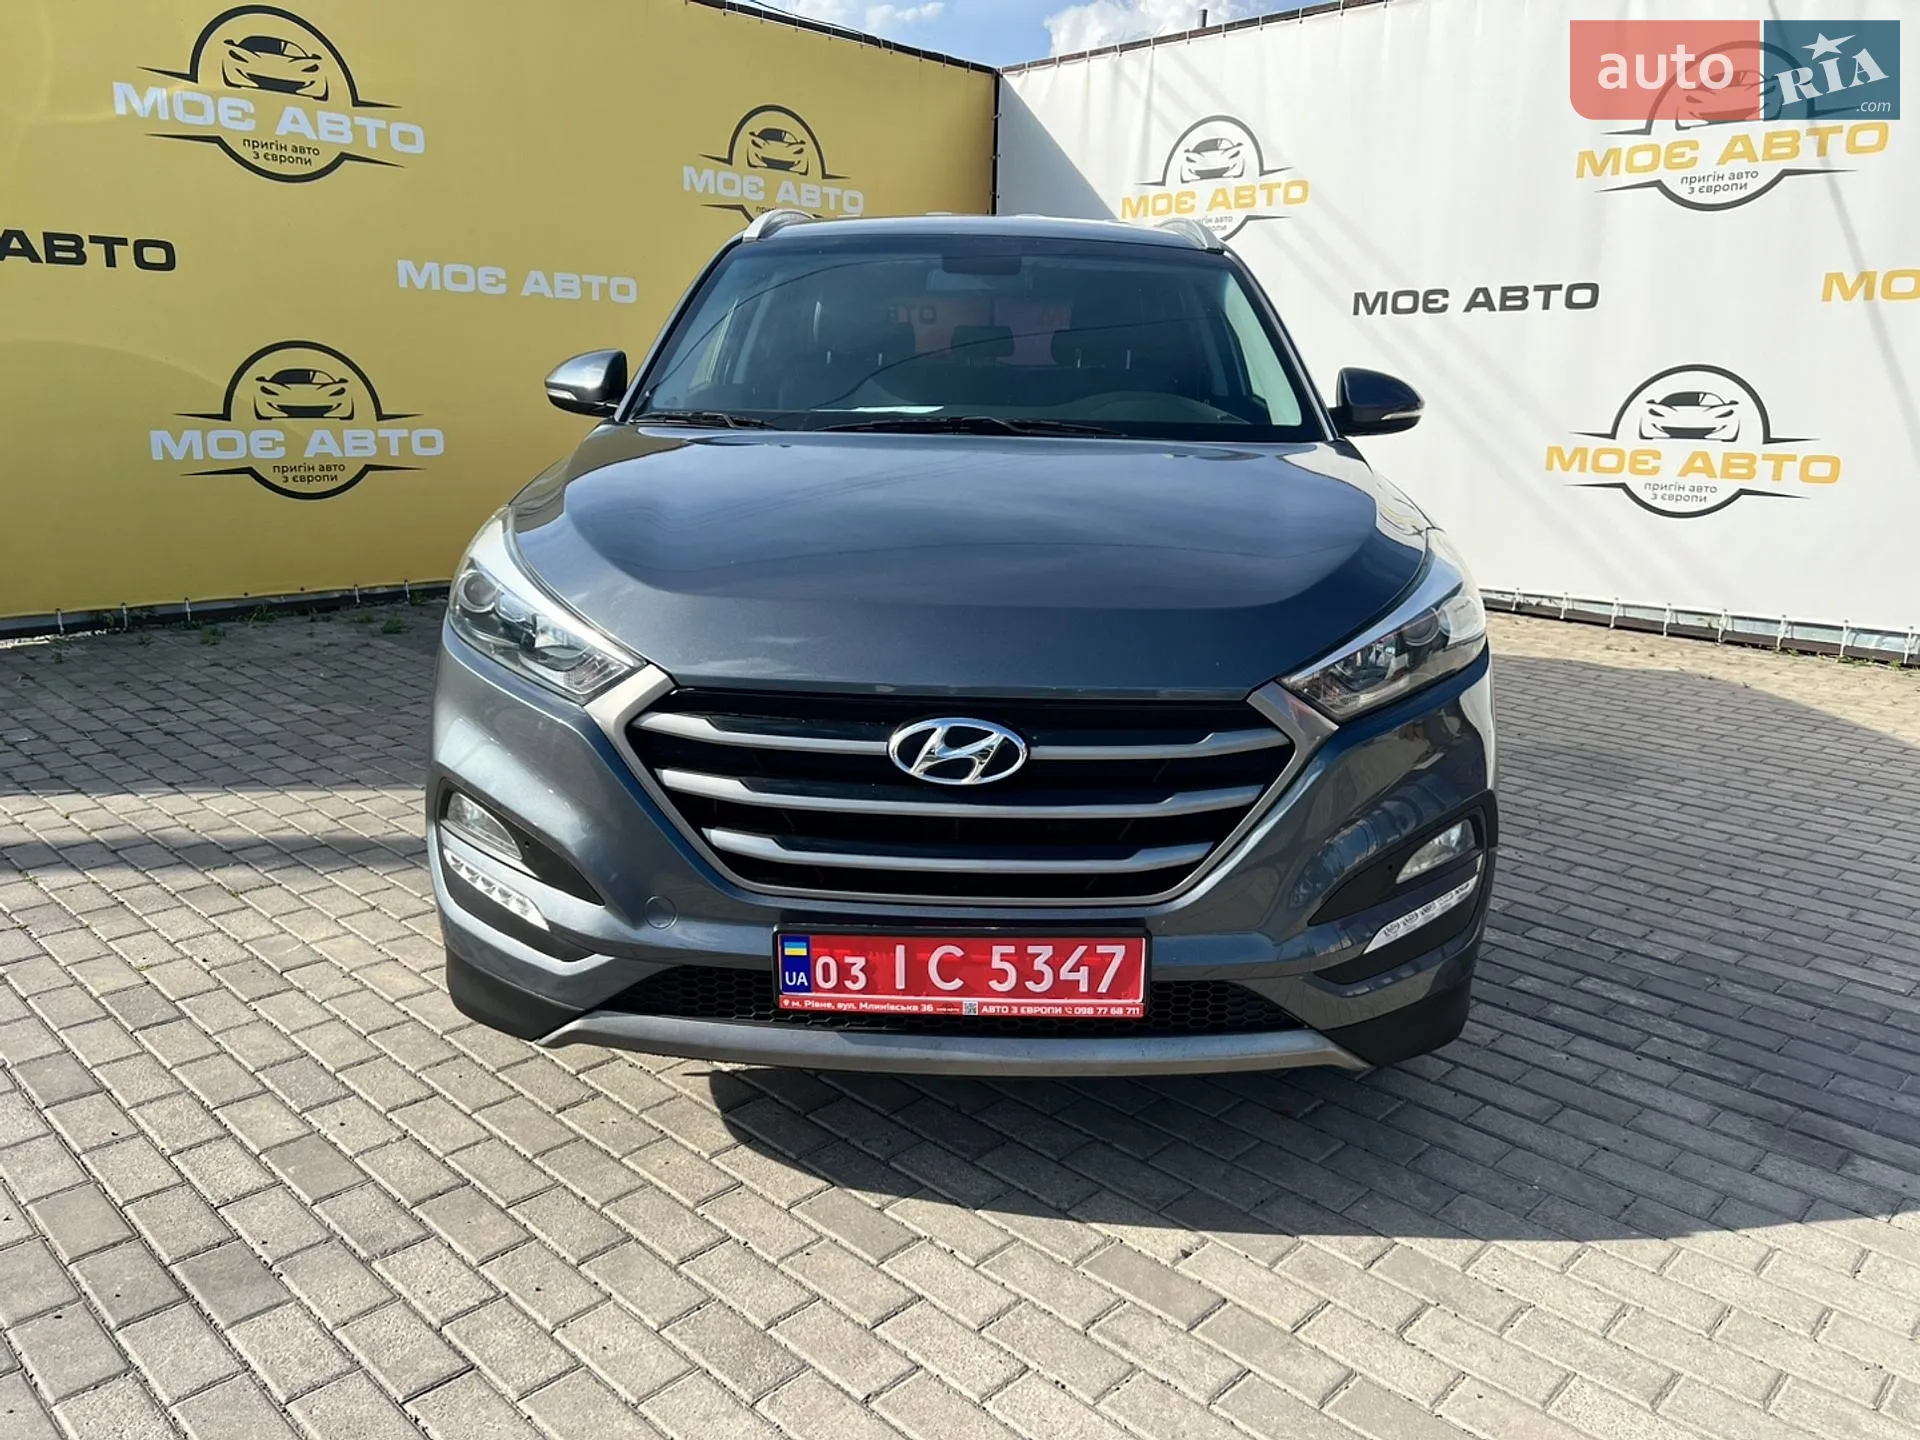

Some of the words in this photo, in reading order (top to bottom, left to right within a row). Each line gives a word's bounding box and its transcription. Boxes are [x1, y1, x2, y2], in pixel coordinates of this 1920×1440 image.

[112, 81, 255, 132] МОЄ
[275, 106, 425, 154] АВТО
[242, 138, 288, 153] пригін
[291, 145, 321, 156] авто
[263, 152, 313, 167] європи
[1576, 139, 1699, 179] МОЄ
[1716, 122, 1889, 166] АВТО
[682, 165, 765, 201] МОЄ
[776, 180, 864, 215] АВТО
[1680, 172, 1725, 186] пригін
[1728, 170, 1759, 182] авто
[1698, 181, 1748, 195] європи
[1121, 190, 1197, 220] МОЄ
[1207, 180, 1310, 212] АВТО
[0, 229, 176, 272] АВТО
[397, 259, 507, 295] МОЄ
[520, 270, 637, 304] АВТО
[1352, 288, 1450, 316] МОЄ
[1462, 282, 1600, 313] АВТО
[150, 429, 286, 461] МОЄ
[303, 428, 445, 458] АВТО
[272, 463, 315, 475] пригін
[318, 463, 345, 473] авто
[1545, 446, 1662, 476] МОЄ
[1677, 451, 1841, 484] АВТО
[292, 474, 338, 485] європи
[1643, 481, 1686, 493] пригін
[1688, 484, 1717, 494] авто
[1660, 493, 1707, 504] європи
[785, 971, 809, 987] UA
[815, 955, 867, 991] 03
[988, 945, 1126, 993] 5347
[981, 1005, 1009, 1014] АВТО
[1020, 1006, 1062, 1015] ЄВРОПИ
[1074, 1007, 1093, 1015] 098
[1096, 1007, 1107, 1015] 77
